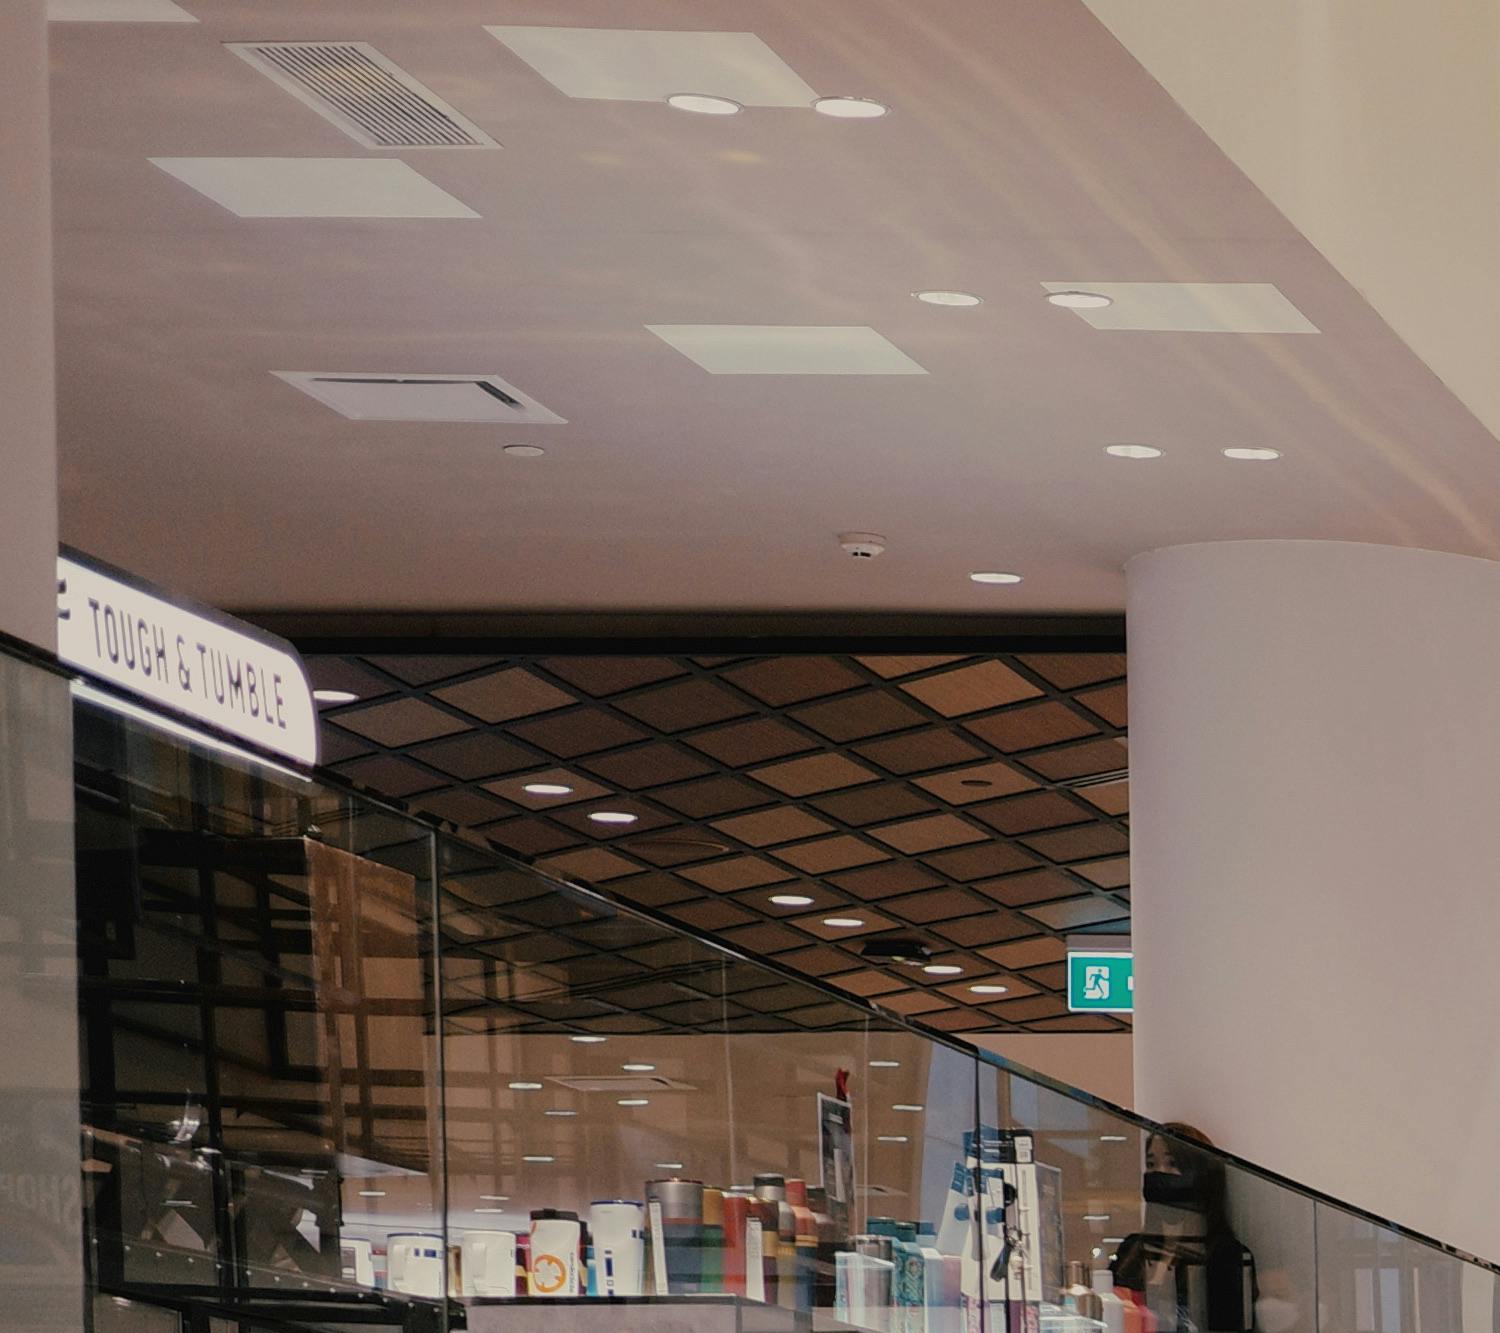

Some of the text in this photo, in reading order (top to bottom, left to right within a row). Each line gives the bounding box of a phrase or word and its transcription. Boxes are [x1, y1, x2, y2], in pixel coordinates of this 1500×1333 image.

[88, 597, 287, 730] TOUGH & TUMBLE
